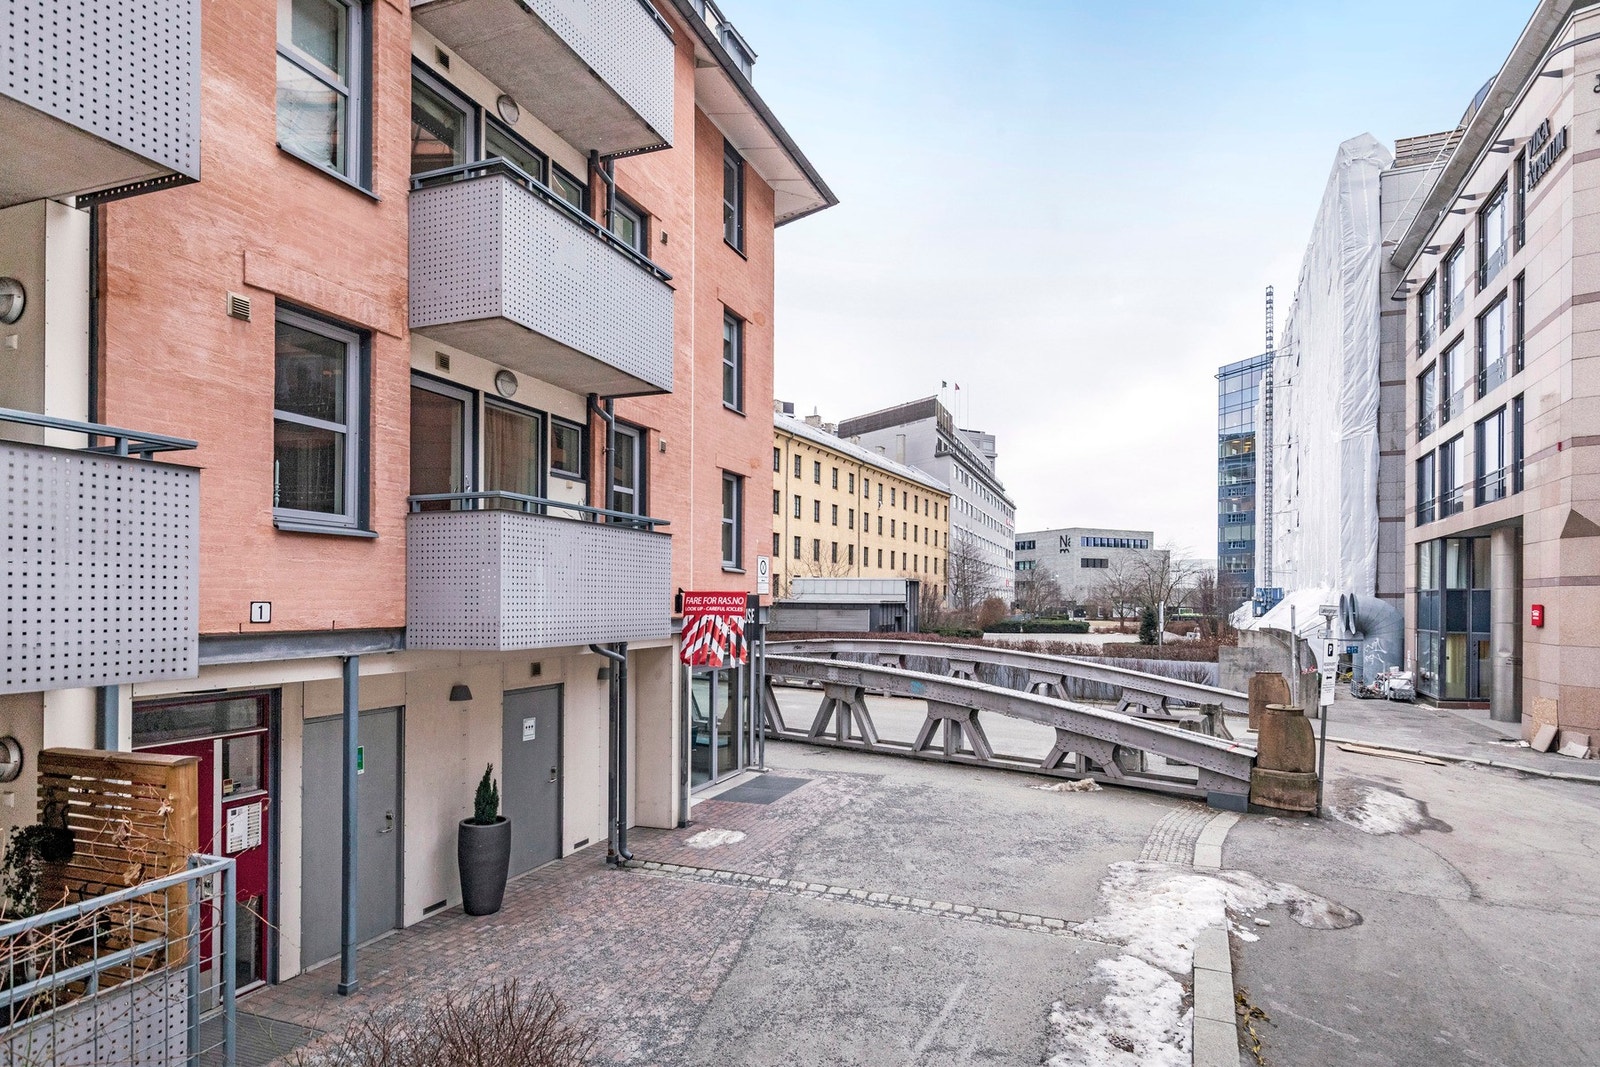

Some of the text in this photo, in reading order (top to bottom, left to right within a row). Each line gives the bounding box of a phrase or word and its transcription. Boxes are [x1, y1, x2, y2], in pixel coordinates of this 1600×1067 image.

[1527, 117, 1551, 159] VIKA
[1527, 125, 1567, 193] ATRIUM
[685, 596, 703, 605] FARE
[703, 596, 717, 605] FOR
